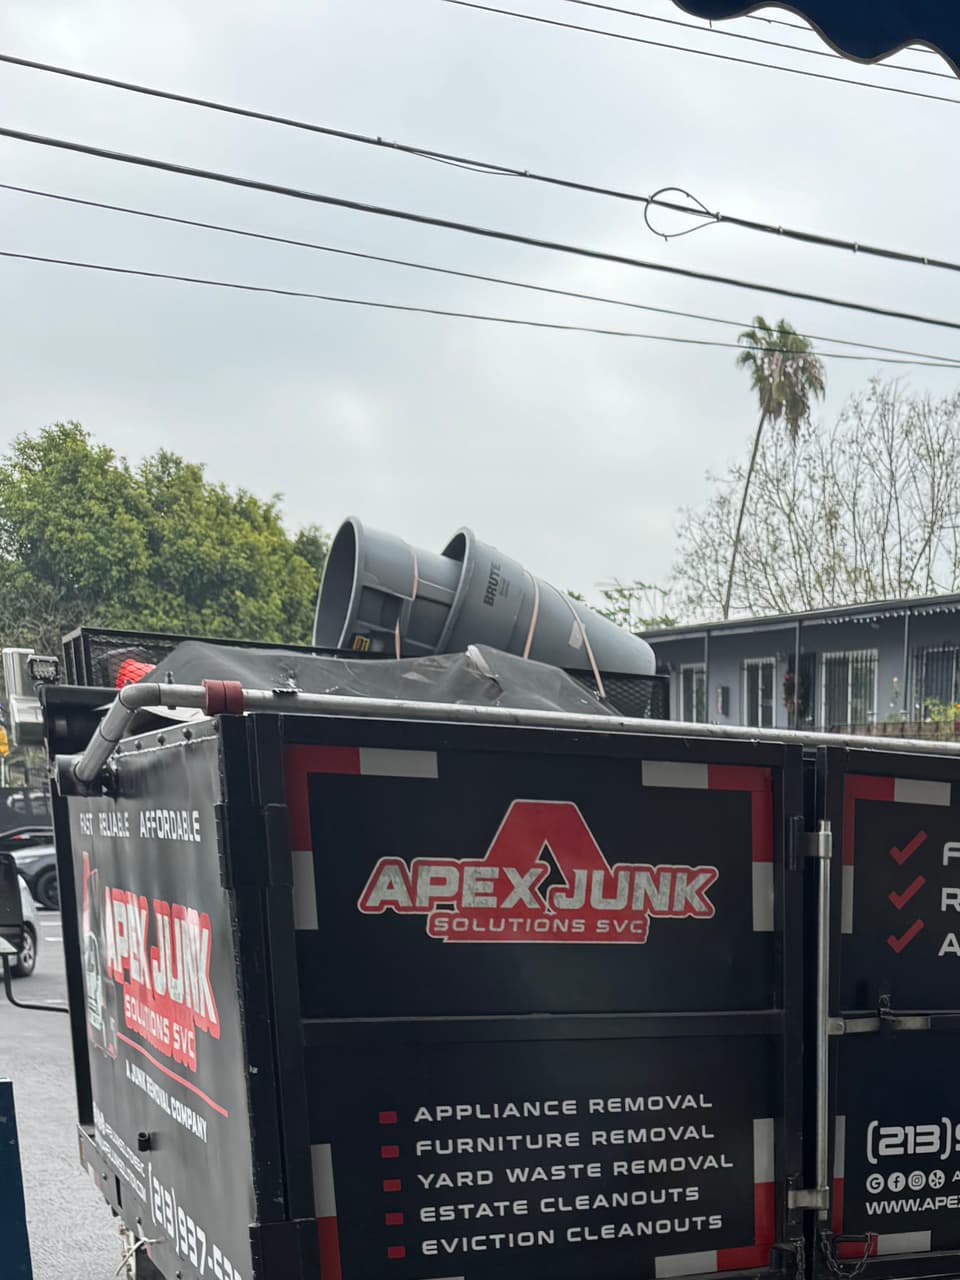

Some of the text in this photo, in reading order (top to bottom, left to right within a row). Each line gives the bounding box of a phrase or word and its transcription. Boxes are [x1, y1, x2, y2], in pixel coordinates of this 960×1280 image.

[483, 562, 501, 607] BRUTE
[80, 809, 200, 841] FAST RELIABLE AFFORDABLE
[365, 865, 712, 913] APEX JUNK
[433, 917, 644, 934] SOLUTIONS SVC
[104, 886, 217, 1024] APEX JUNK
[124, 995, 195, 1059] SOLUTIONS SVC
[170, 1096, 207, 1143] COMPANY
[414, 1094, 713, 1123] APPLIANCE REMOVAL
[416, 1124, 715, 1156] FURNITURE REMOVAL
[418, 1154, 734, 1189] YARD WASTE REMOVAL
[420, 1186, 700, 1223] ESTATE CLEANOUTS
[421, 1214, 723, 1255] EVICTION CLEANOUTS
